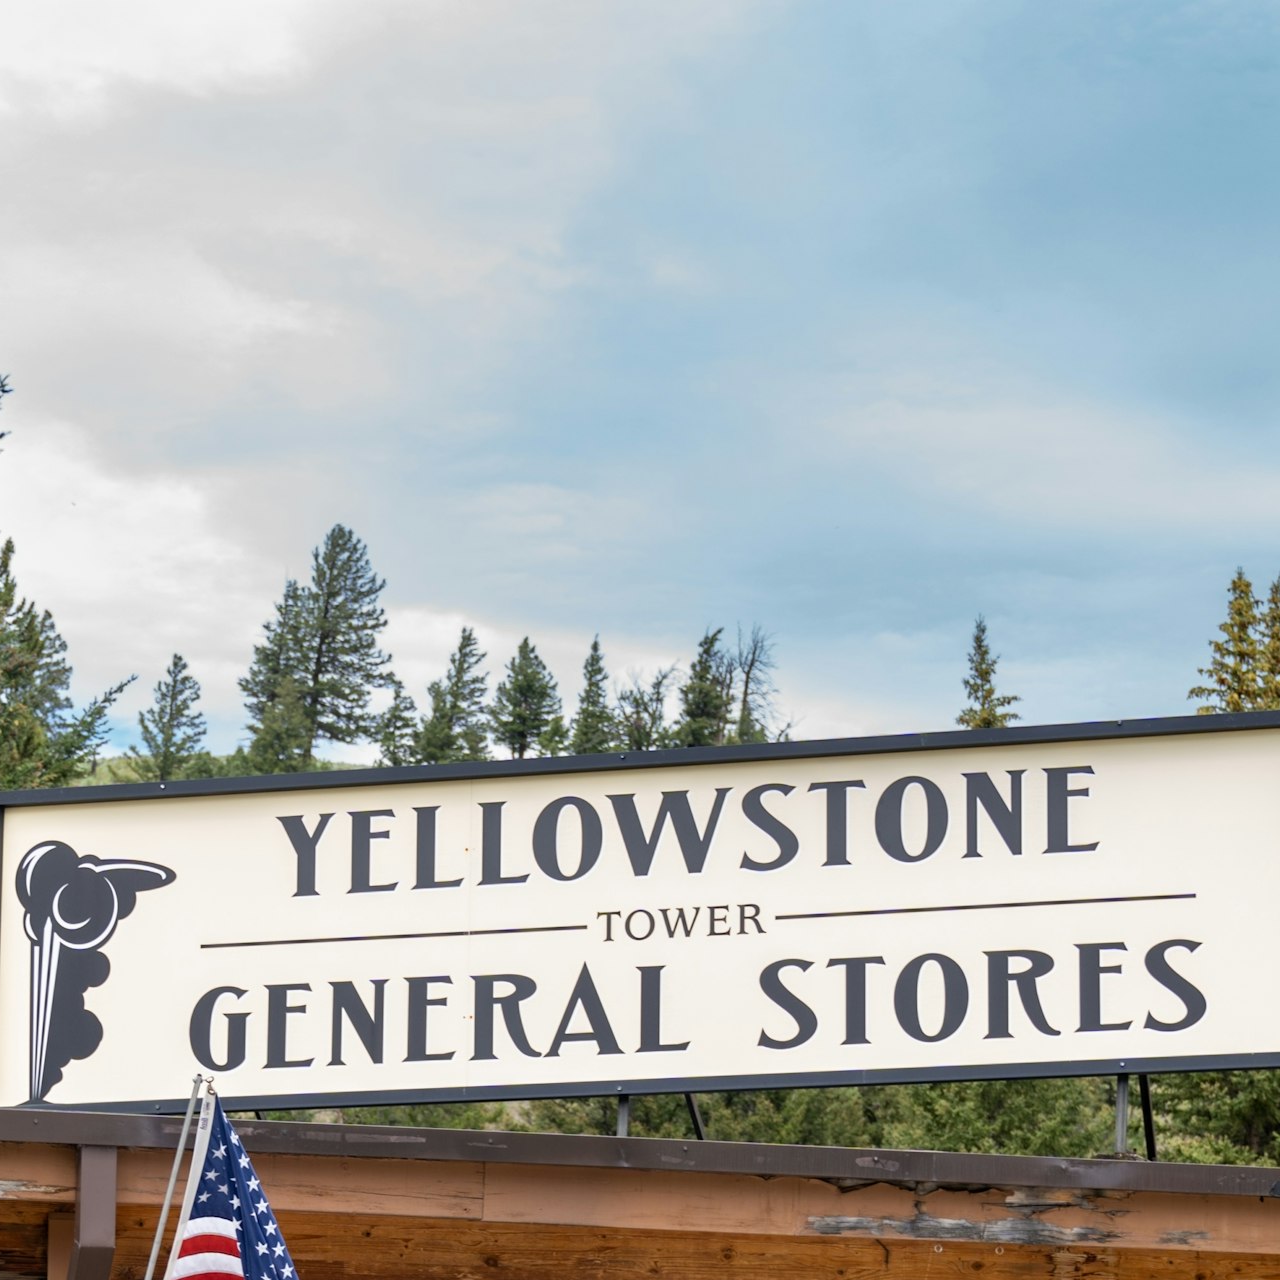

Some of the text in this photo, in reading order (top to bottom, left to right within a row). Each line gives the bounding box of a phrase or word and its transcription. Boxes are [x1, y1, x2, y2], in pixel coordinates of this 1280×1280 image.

[275, 766, 1100, 898] YELLOWSTONE
[596, 903, 768, 942] TOWER
[189, 938, 1208, 1072] GENERAL STORES
